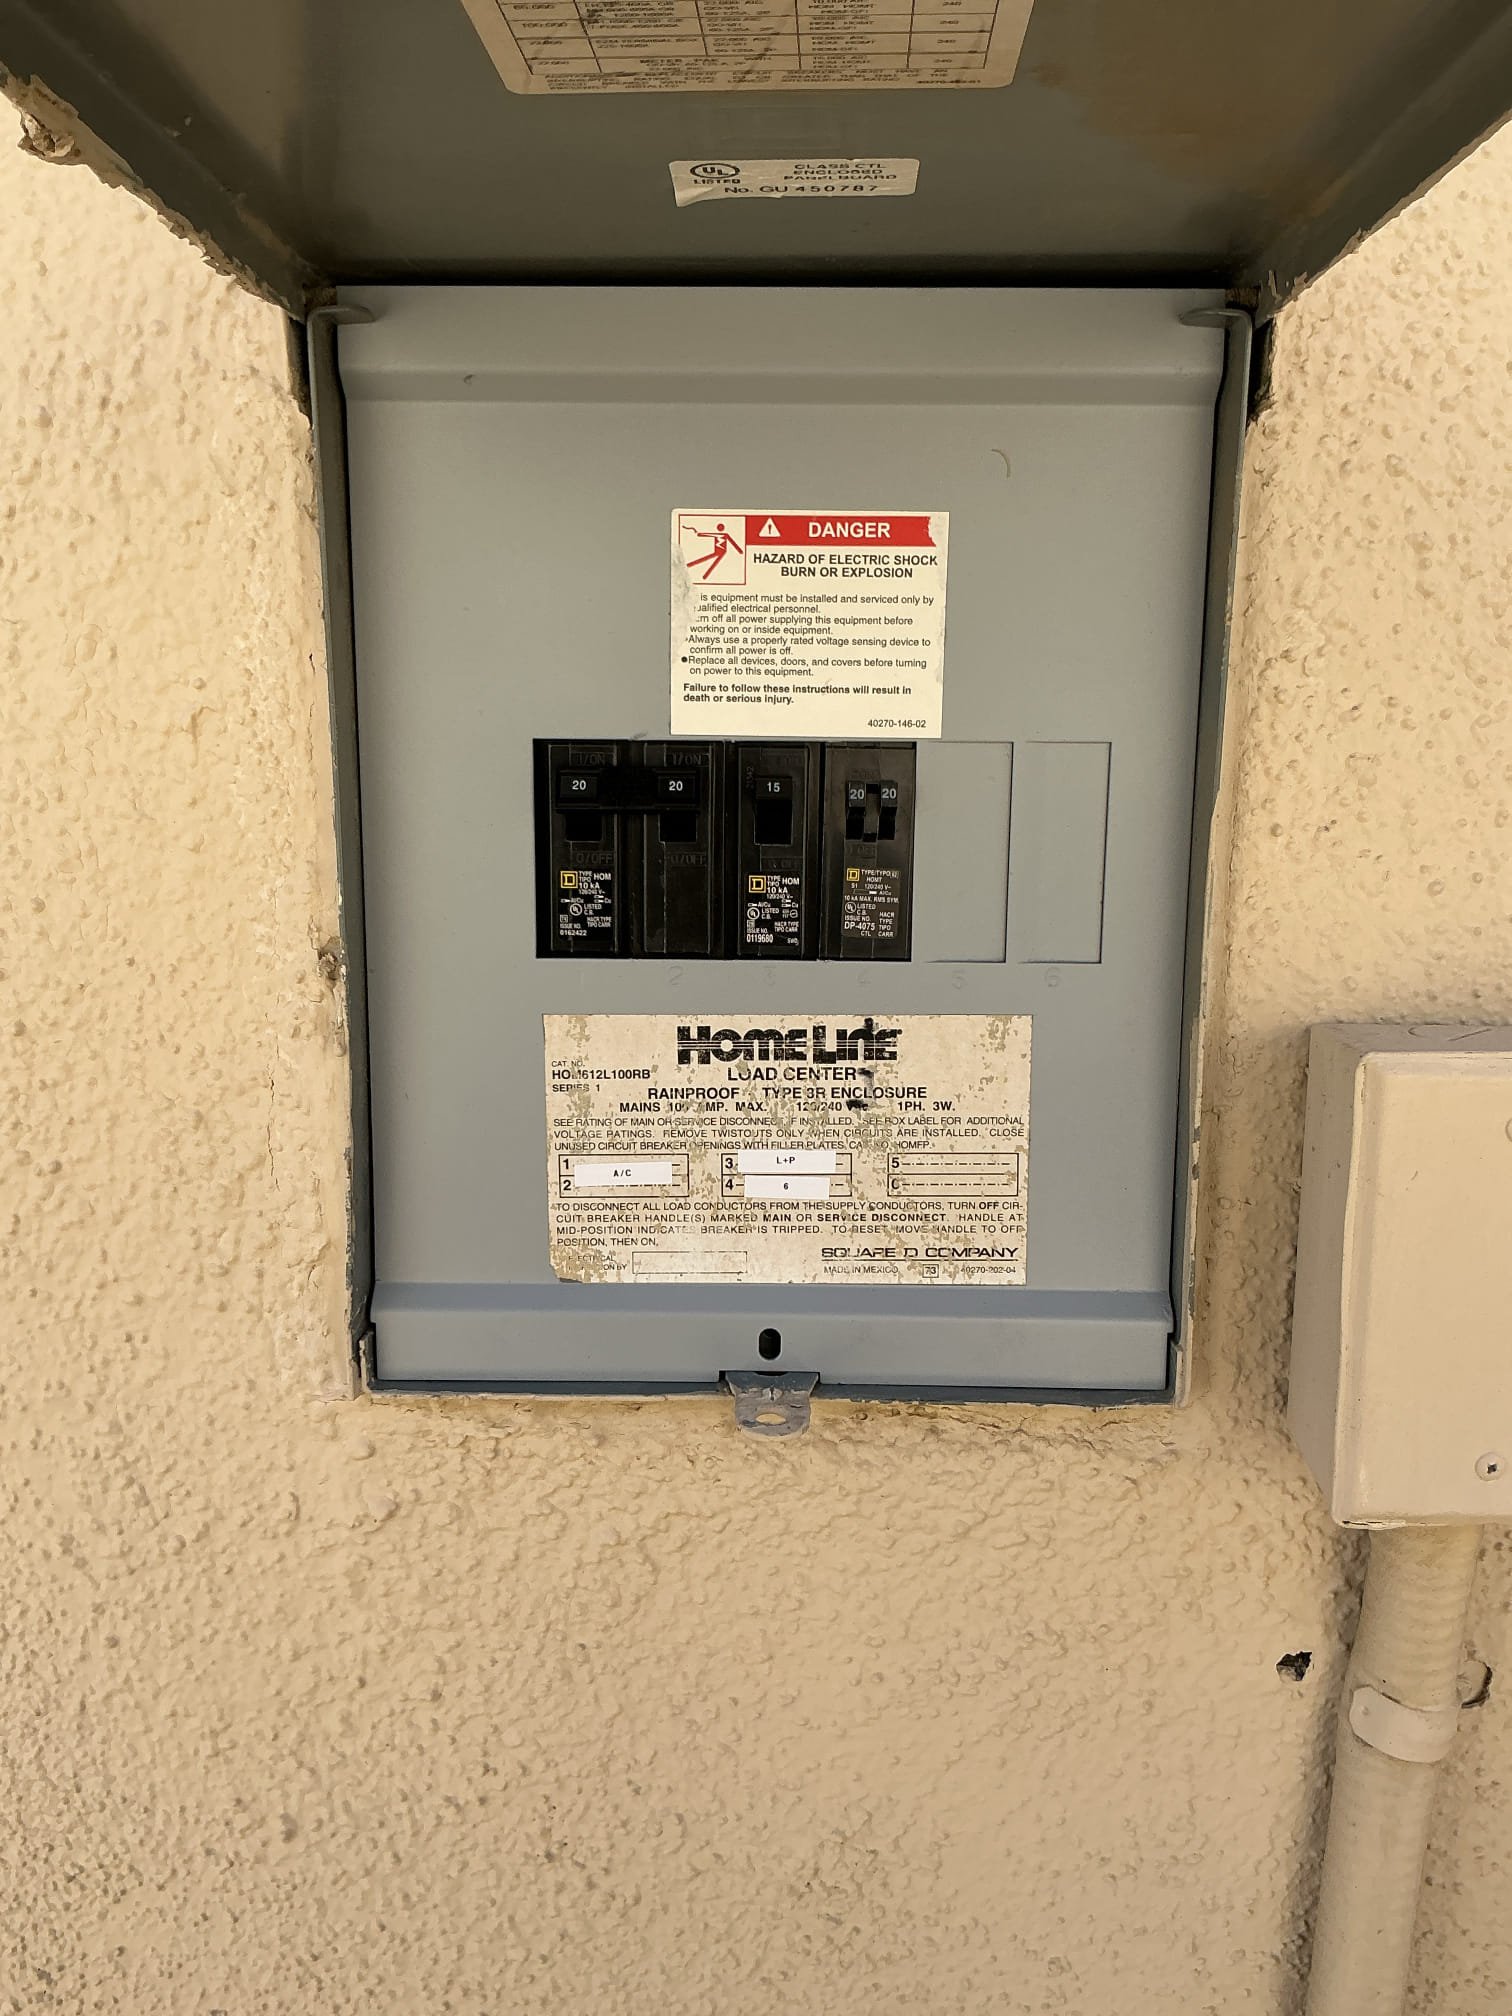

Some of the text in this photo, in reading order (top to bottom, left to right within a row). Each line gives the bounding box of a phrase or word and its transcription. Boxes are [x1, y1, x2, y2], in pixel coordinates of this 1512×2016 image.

[808, 522, 890, 538] DANGER
[753, 553, 937, 566] HAZARD OF ELECTRIC SHOCK
[781, 567, 913, 578] BURN OR EXPLOSION
[711, 594, 758, 602] equipment
[786, 594, 797, 602] be
[801, 595, 837, 603] installed
[840, 595, 857, 603] and
[901, 596, 920, 606] only
[922, 596, 934, 606] by
[731, 604, 820, 614] electrical personnel.
[712, 614, 723, 622] off
[726, 615, 736, 623] all
[739, 616, 766, 624] power
[769, 616, 812, 626] supplying
[816, 616, 831, 624] this
[834, 617, 881, 626] equipment
[884, 617, 913, 625] before
[690, 625, 724, 635] working
[783, 627, 833, 635] equipment.
[688, 635, 720, 645] Always
[751, 637, 788, 646] properly
[791, 637, 813, 645] rated
[816, 637, 849, 647] voltage
[852, 638, 886, 648] sensing
[890, 638, 919, 646] device
[690, 646, 723, 654] confirm
[726, 646, 736, 654] all
[739, 647, 766, 656] power
[780, 646, 793, 655] off.
[689, 656, 725, 666] Replace
[728, 657, 738, 665] all
[741, 657, 778, 666] devices,
[781, 658, 808, 666] doors,
[812, 658, 828, 666] and
[864, 658, 893, 666] before
[896, 659, 926, 669] turning
[704, 668, 731, 676] power
[735, 667, 743, 675] to
[746, 667, 761, 675] this
[764, 667, 814, 677] equipment.
[684, 683, 911, 694] Failure to follow these instructions will result in
[684, 694, 710, 702] death
[765, 695, 794, 705] injury.
[868, 720, 926, 728] 40270-146-02
[572, 780, 586, 791] 20
[669, 781, 683, 791] 20
[767, 782, 780, 792] 15
[850, 788, 896, 799] 20 20
[845, 922, 875, 930] DP-4075
[728, 1068, 857, 1080] LOAD CENTER
[648, 1087, 926, 1099] RAINPROOF TYPE 3R ENCLOSURE
[620, 1103, 660, 1112] MAINS
[736, 1102, 767, 1111] MAX.
[898, 1102, 925, 1111] 1PH.
[933, 1102, 955, 1111] 3W.
[631, 1118, 654, 1126] MAIN
[908, 1117, 939, 1125] LABEL
[941, 1117, 961, 1125] FOR
[967, 1117, 1024, 1125] ADDITIONAL
[554, 1130, 602, 1138] VOLTAGE
[712, 1129, 772, 1137] TWISTOUTS
[777, 1129, 804, 1137] ONLY
[555, 1142, 595, 1150] UNUSED
[598, 1142, 637, 1150] CIRCUIT
[564, 1159, 569, 1169] 1
[725, 1158, 733, 1168] 3
[891, 1158, 900, 1168] 5
[613, 1169, 631, 1177] A/C
[563, 1180, 571, 1190] 2
[725, 1180, 733, 1189] 4
[556, 1203, 569, 1211] TO
[573, 1203, 640, 1211] DISCONNECT
[694, 1202, 766, 1210] CONDUCTORS
[770, 1202, 799, 1210] FROM
[803, 1202, 822, 1210] THE
[825, 1202, 865, 1210] SUPPLY
[645, 1214, 706, 1222] HANDLE(S)
[711, 1214, 758, 1222] MARKED
[763, 1214, 791, 1222] MAIN
[557, 1226, 632, 1234] MID-POSITION
[557, 1238, 608, 1246] POSITION,
[926, 1248, 1018, 1257] COMPANY
